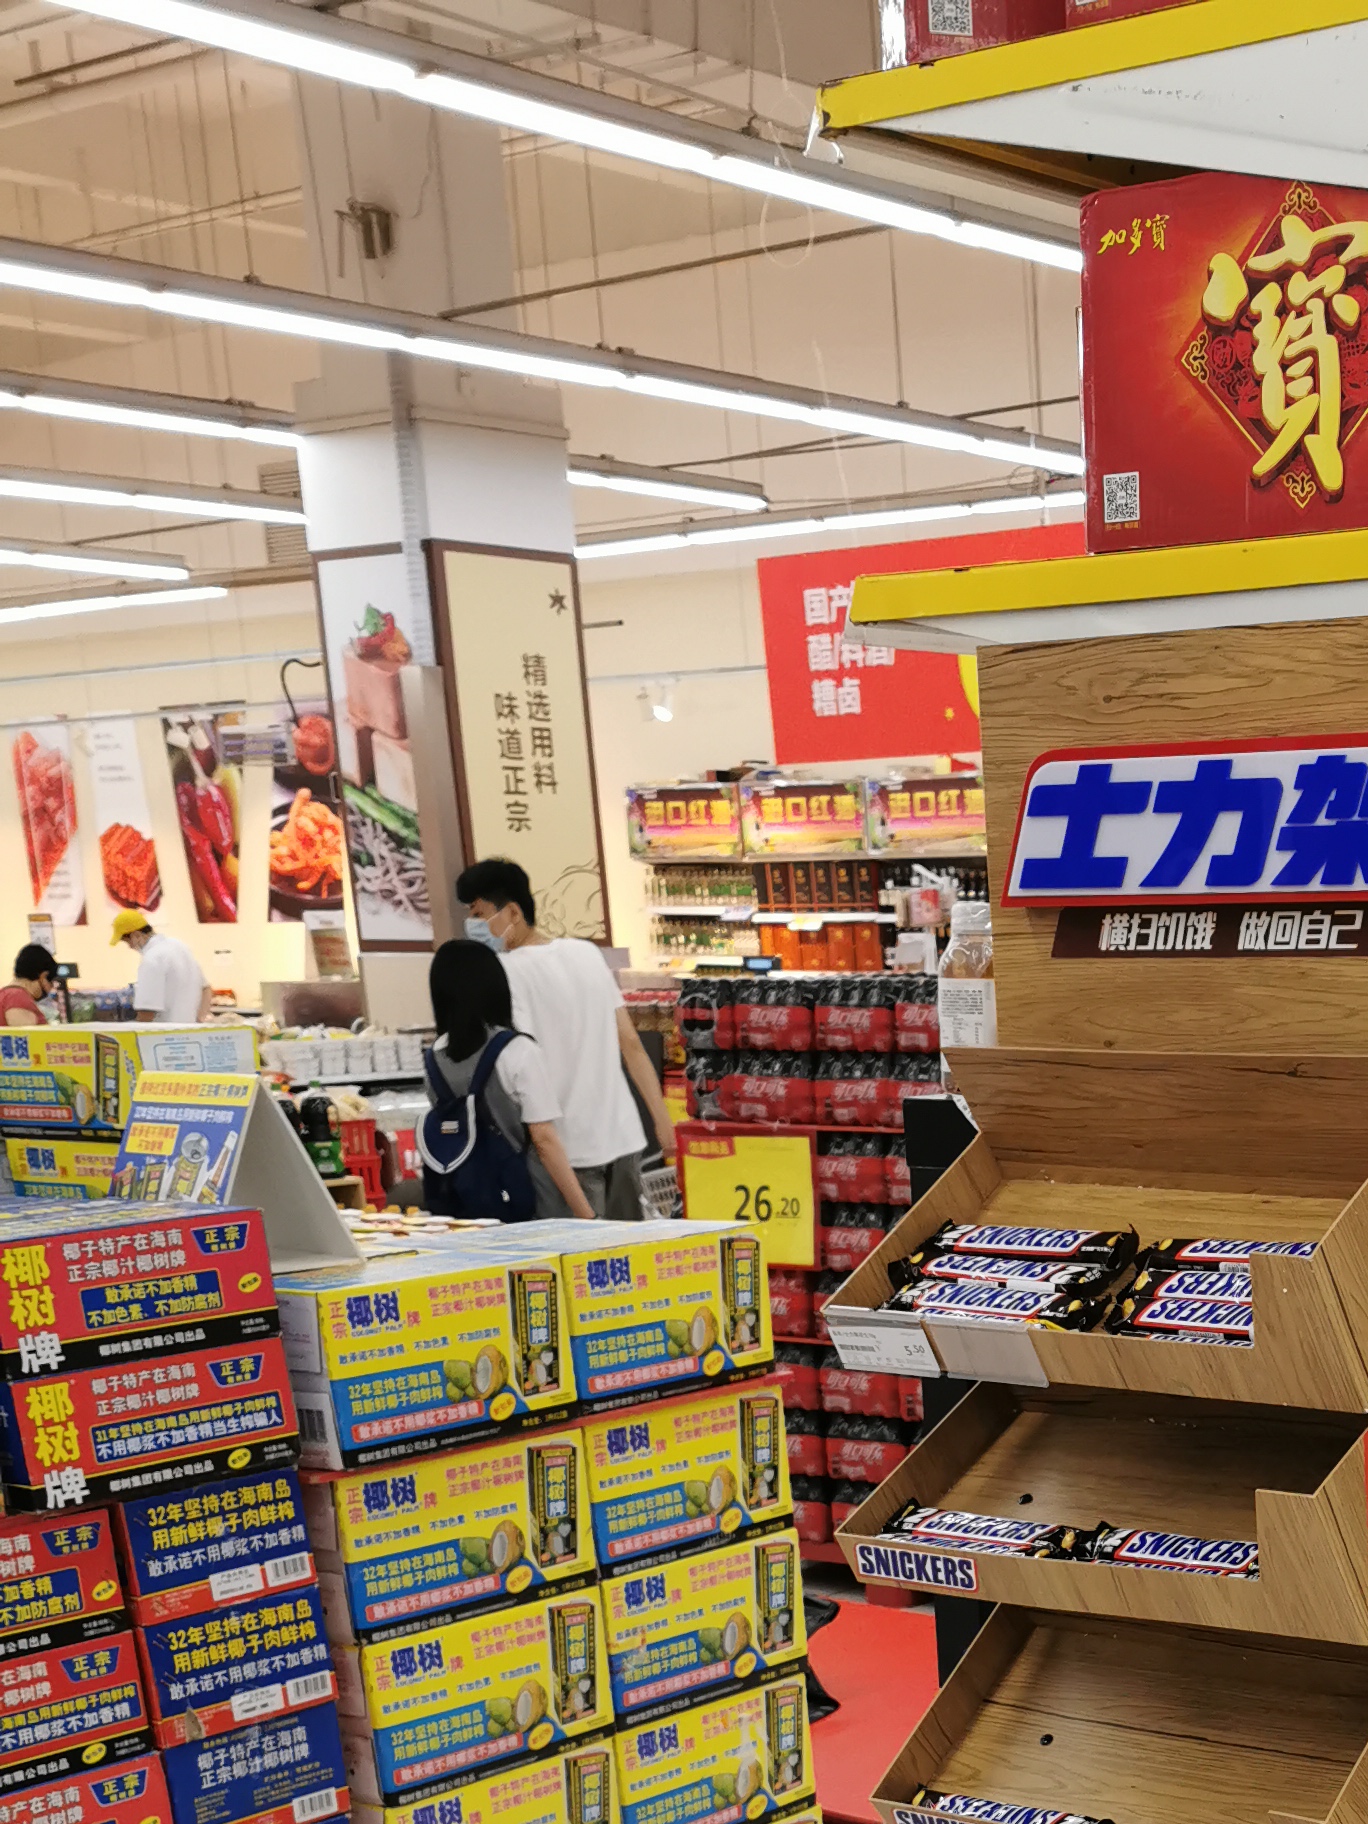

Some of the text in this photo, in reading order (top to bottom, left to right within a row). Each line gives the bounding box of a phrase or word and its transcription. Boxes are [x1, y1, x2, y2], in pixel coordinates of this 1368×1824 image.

[520, 652, 559, 796] 精选用料
[493, 690, 532, 834] 味道正宗
[1099, 910, 1364, 952] 横扫饥饿 做回自己
[62, 1228, 183, 1261] 椰子特产在海南
[67, 1249, 187, 1284] 正宗椰汁椰树牌
[346, 1293, 401, 1330] 椰树
[147, 1478, 291, 1527] 32年坚持在海南岛
[362, 1475, 418, 1513] 椰树
[152, 1500, 297, 1552] 用新鲜椰子肉鲜榨
[147, 1524, 307, 1580] 敢承诺不用椰浆不加香精
[859, 1547, 976, 1590] SNICKERS
[167, 1599, 313, 1652] 32年坚持在海南岛
[173, 1620, 318, 1676] 用新鲜椰子肉鲜榨
[198, 1725, 308, 1772] 椰子特产在海南
